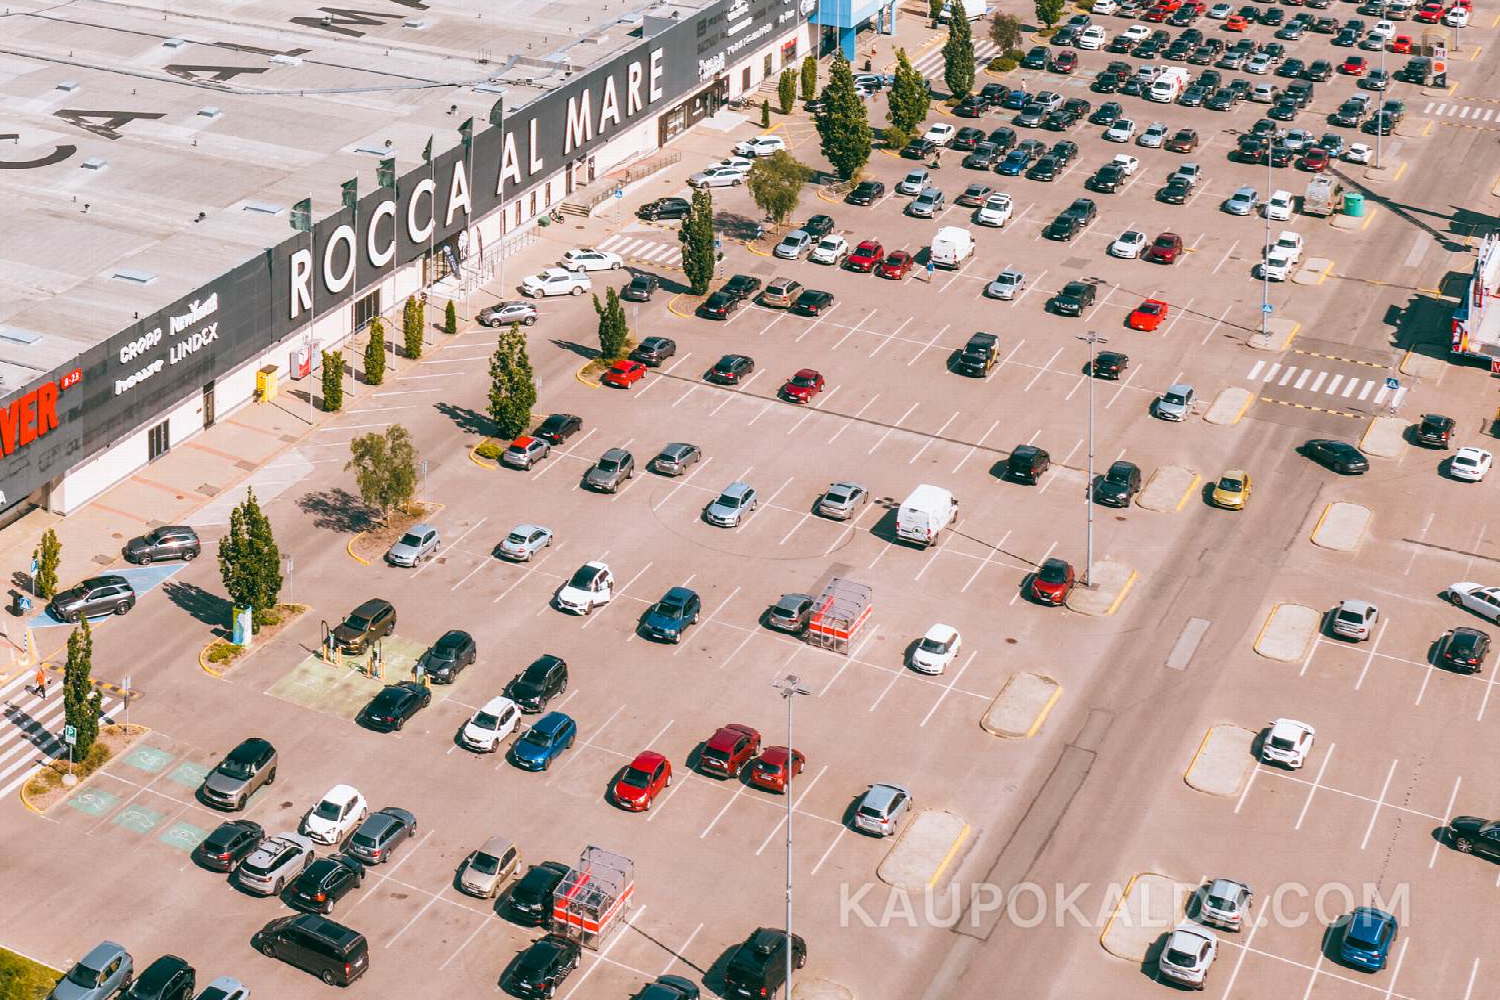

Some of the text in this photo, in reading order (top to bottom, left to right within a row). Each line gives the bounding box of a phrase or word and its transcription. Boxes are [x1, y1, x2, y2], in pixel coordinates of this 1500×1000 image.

[164, 41, 311, 87] AL
[290, 47, 663, 319] ROCCA AL MARE
[120, 327, 162, 364] CROPP
[169, 321, 219, 365] LINDEX
